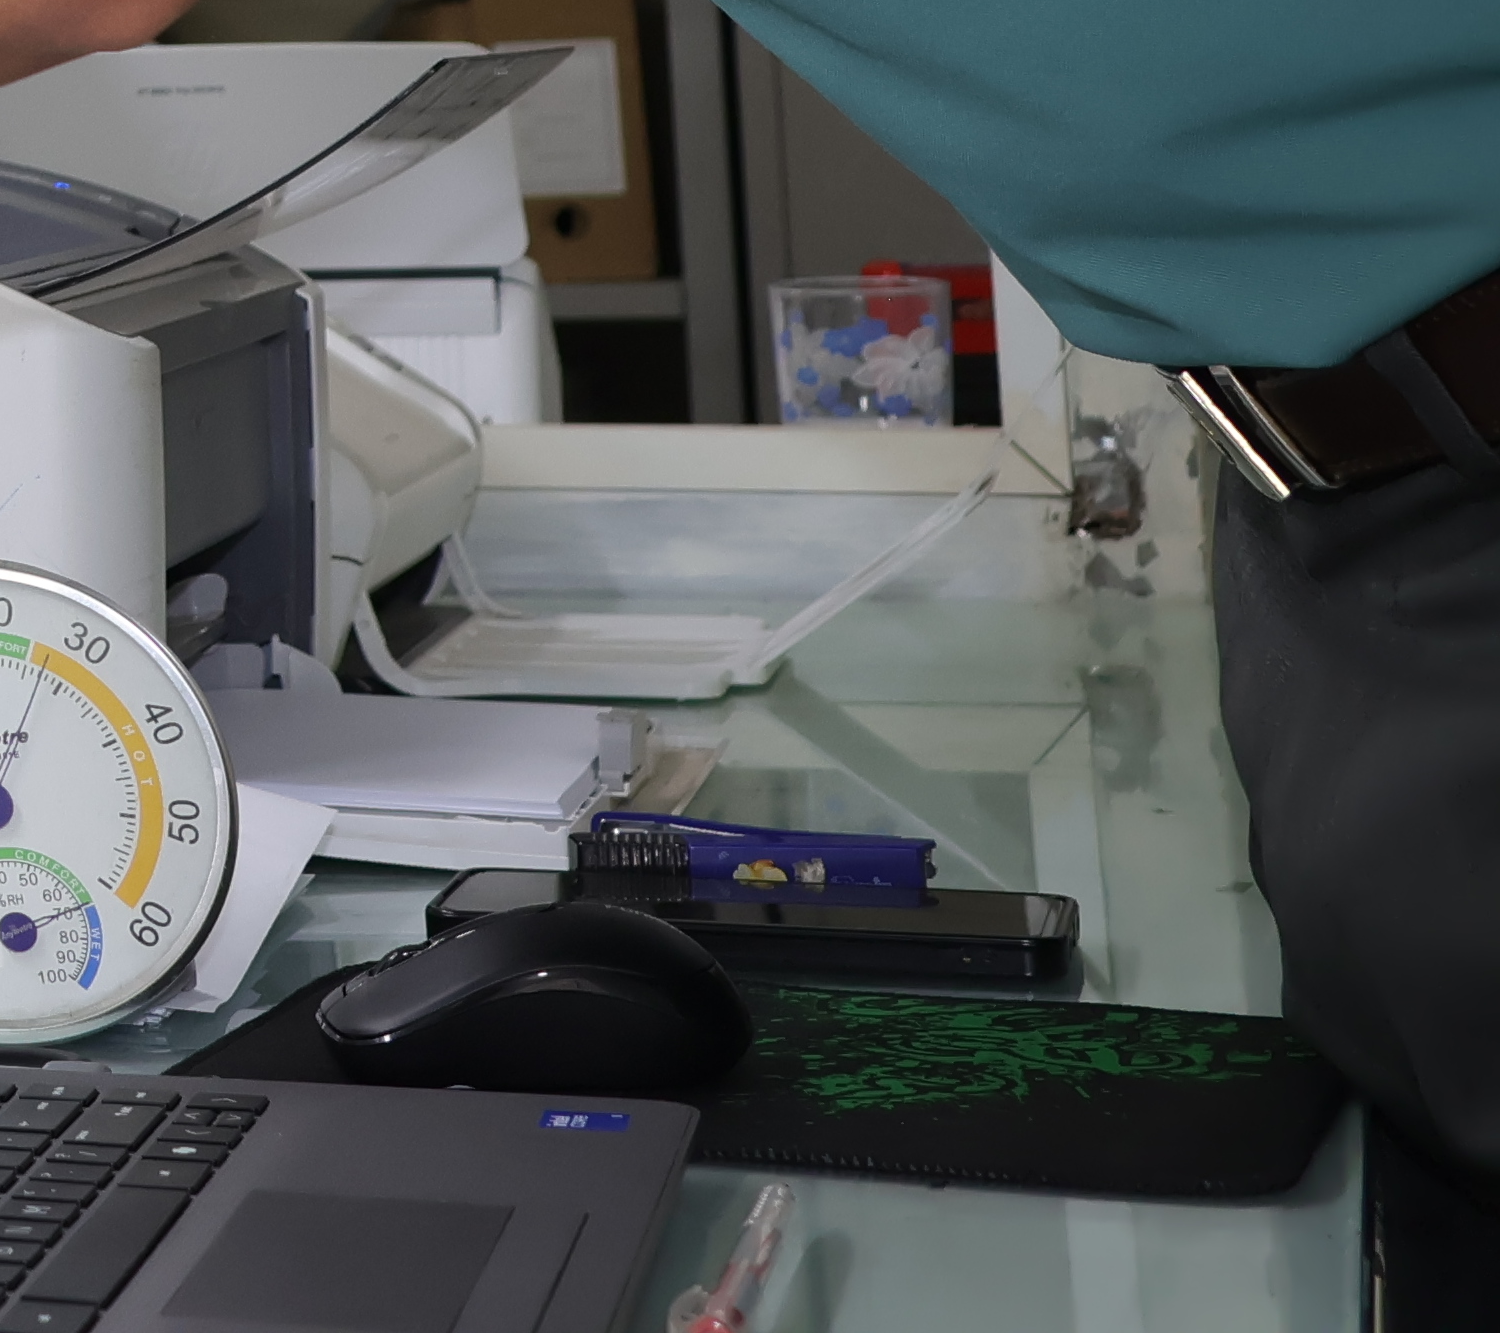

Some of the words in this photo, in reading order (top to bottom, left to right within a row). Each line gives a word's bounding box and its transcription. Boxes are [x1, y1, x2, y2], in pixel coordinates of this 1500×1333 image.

[63, 621, 111, 664] 30
[144, 703, 184, 745] 40
[168, 799, 201, 845] 50
[14, 849, 85, 896] COMFORT
[18, 872, 39, 886] 50
[42, 888, 63, 903] 60
[59, 929, 80, 944] 80
[129, 900, 173, 947] 60
[55, 950, 77, 964] 90
[90, 926, 101, 962] WET
[37, 968, 68, 985] 100
